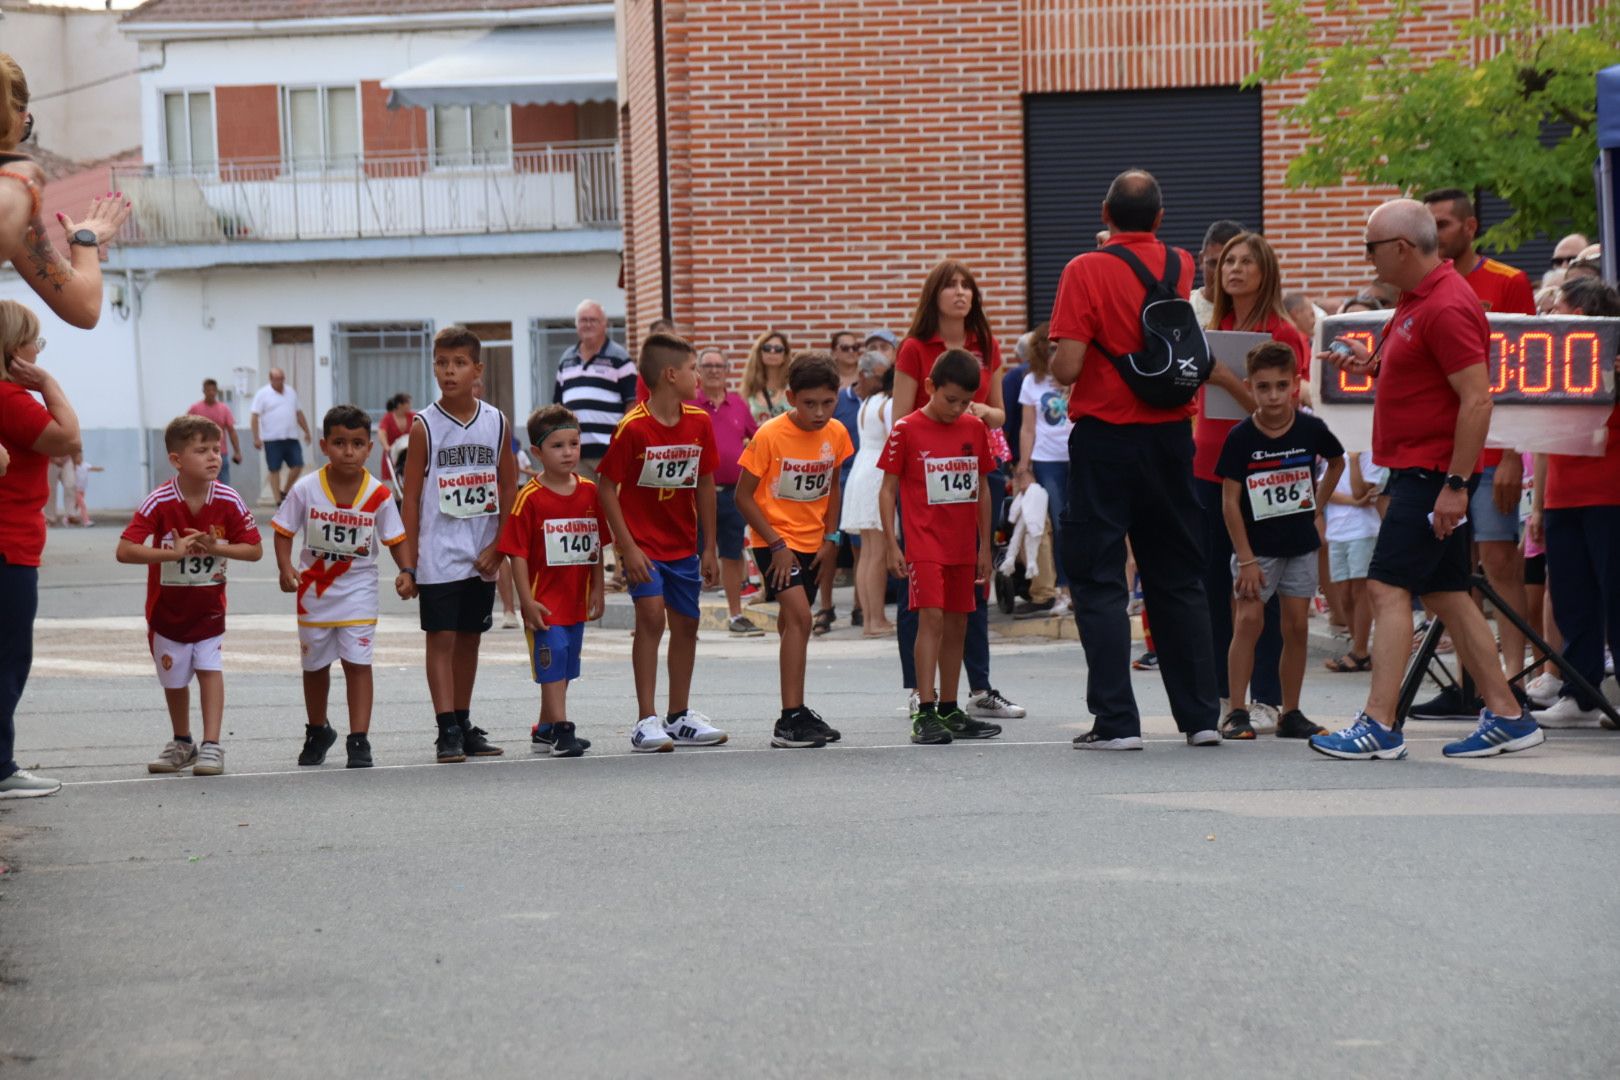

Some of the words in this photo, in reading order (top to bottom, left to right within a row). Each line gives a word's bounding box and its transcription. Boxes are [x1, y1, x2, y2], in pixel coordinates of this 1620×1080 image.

[437, 444, 495, 469] DENVER
[656, 460, 688, 478] 187
[793, 473, 826, 491] 150
[940, 472, 972, 491] 148
[1262, 483, 1300, 506] 186
[321, 523, 358, 546] 151
[559, 534, 591, 553] 140
[177, 555, 215, 575] 139
